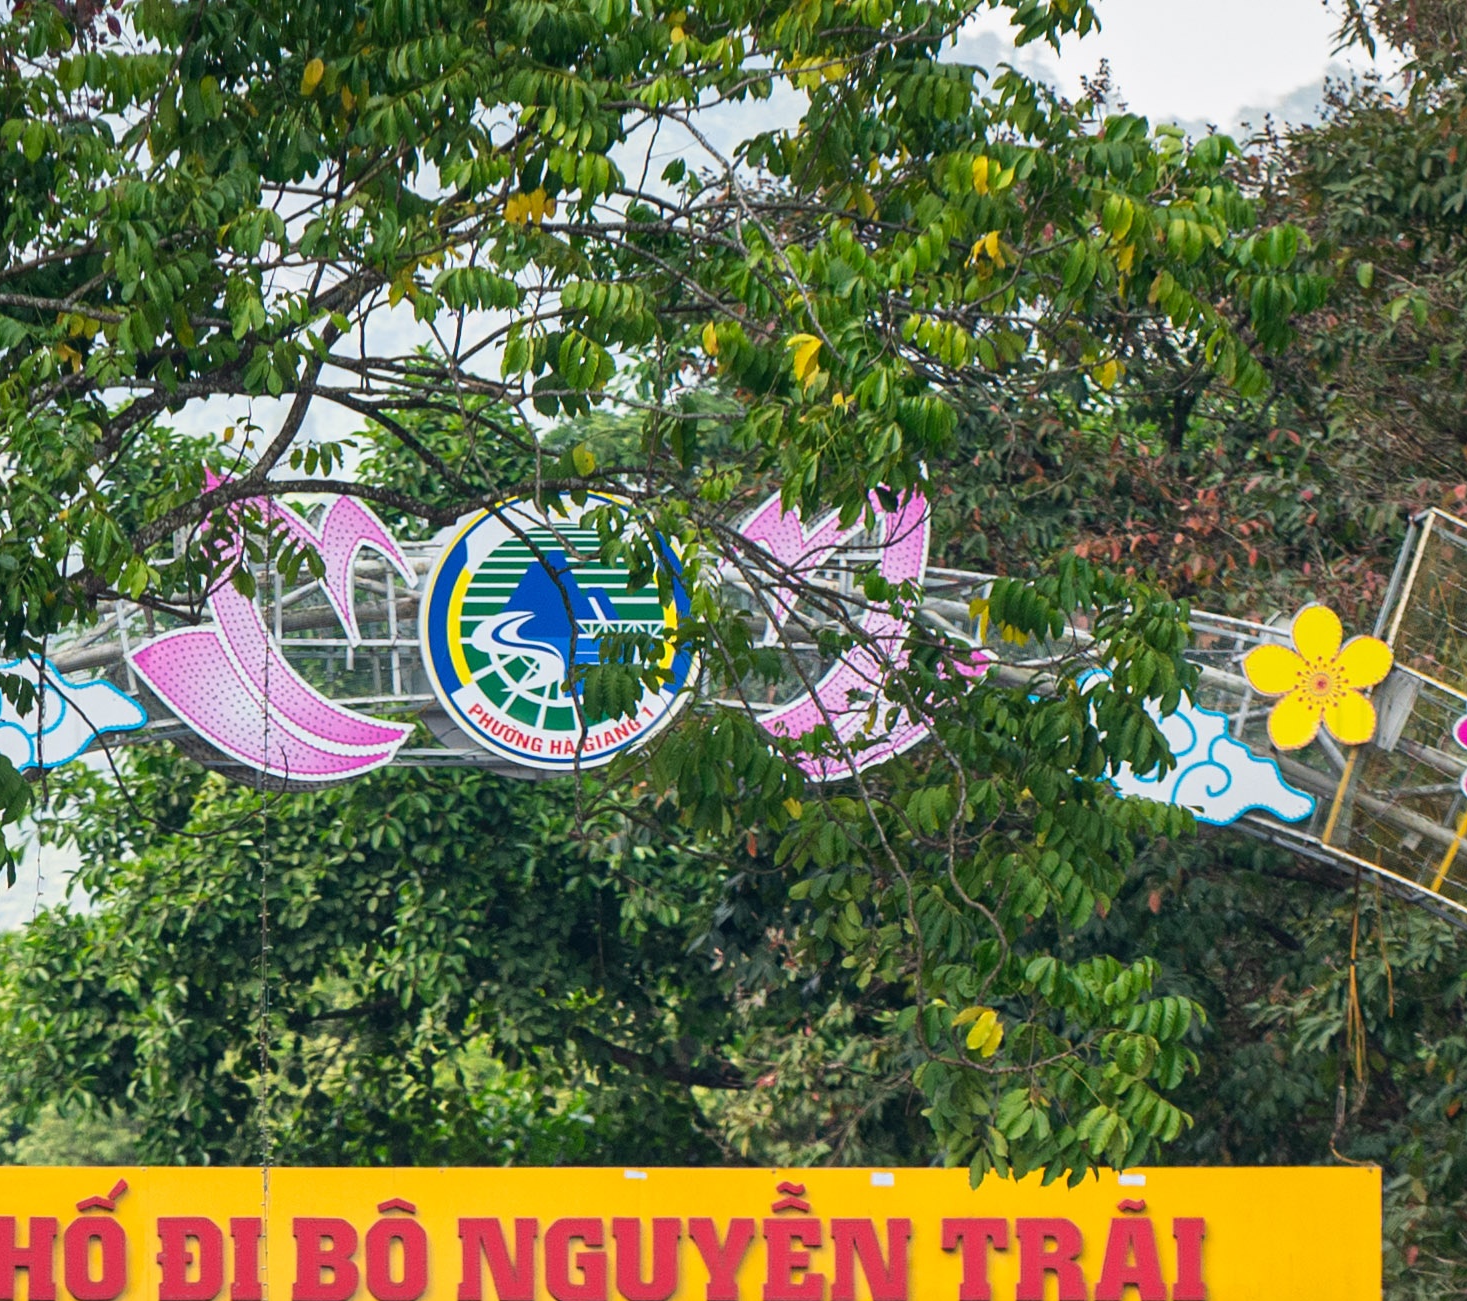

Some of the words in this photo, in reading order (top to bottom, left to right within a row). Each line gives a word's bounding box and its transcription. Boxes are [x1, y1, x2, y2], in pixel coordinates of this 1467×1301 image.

[468, 703, 543, 752] PHƯỜNG
[550, 737, 576, 754] HÀ
[584, 719, 642, 752] GIANG
[641, 706, 654, 718] 1
